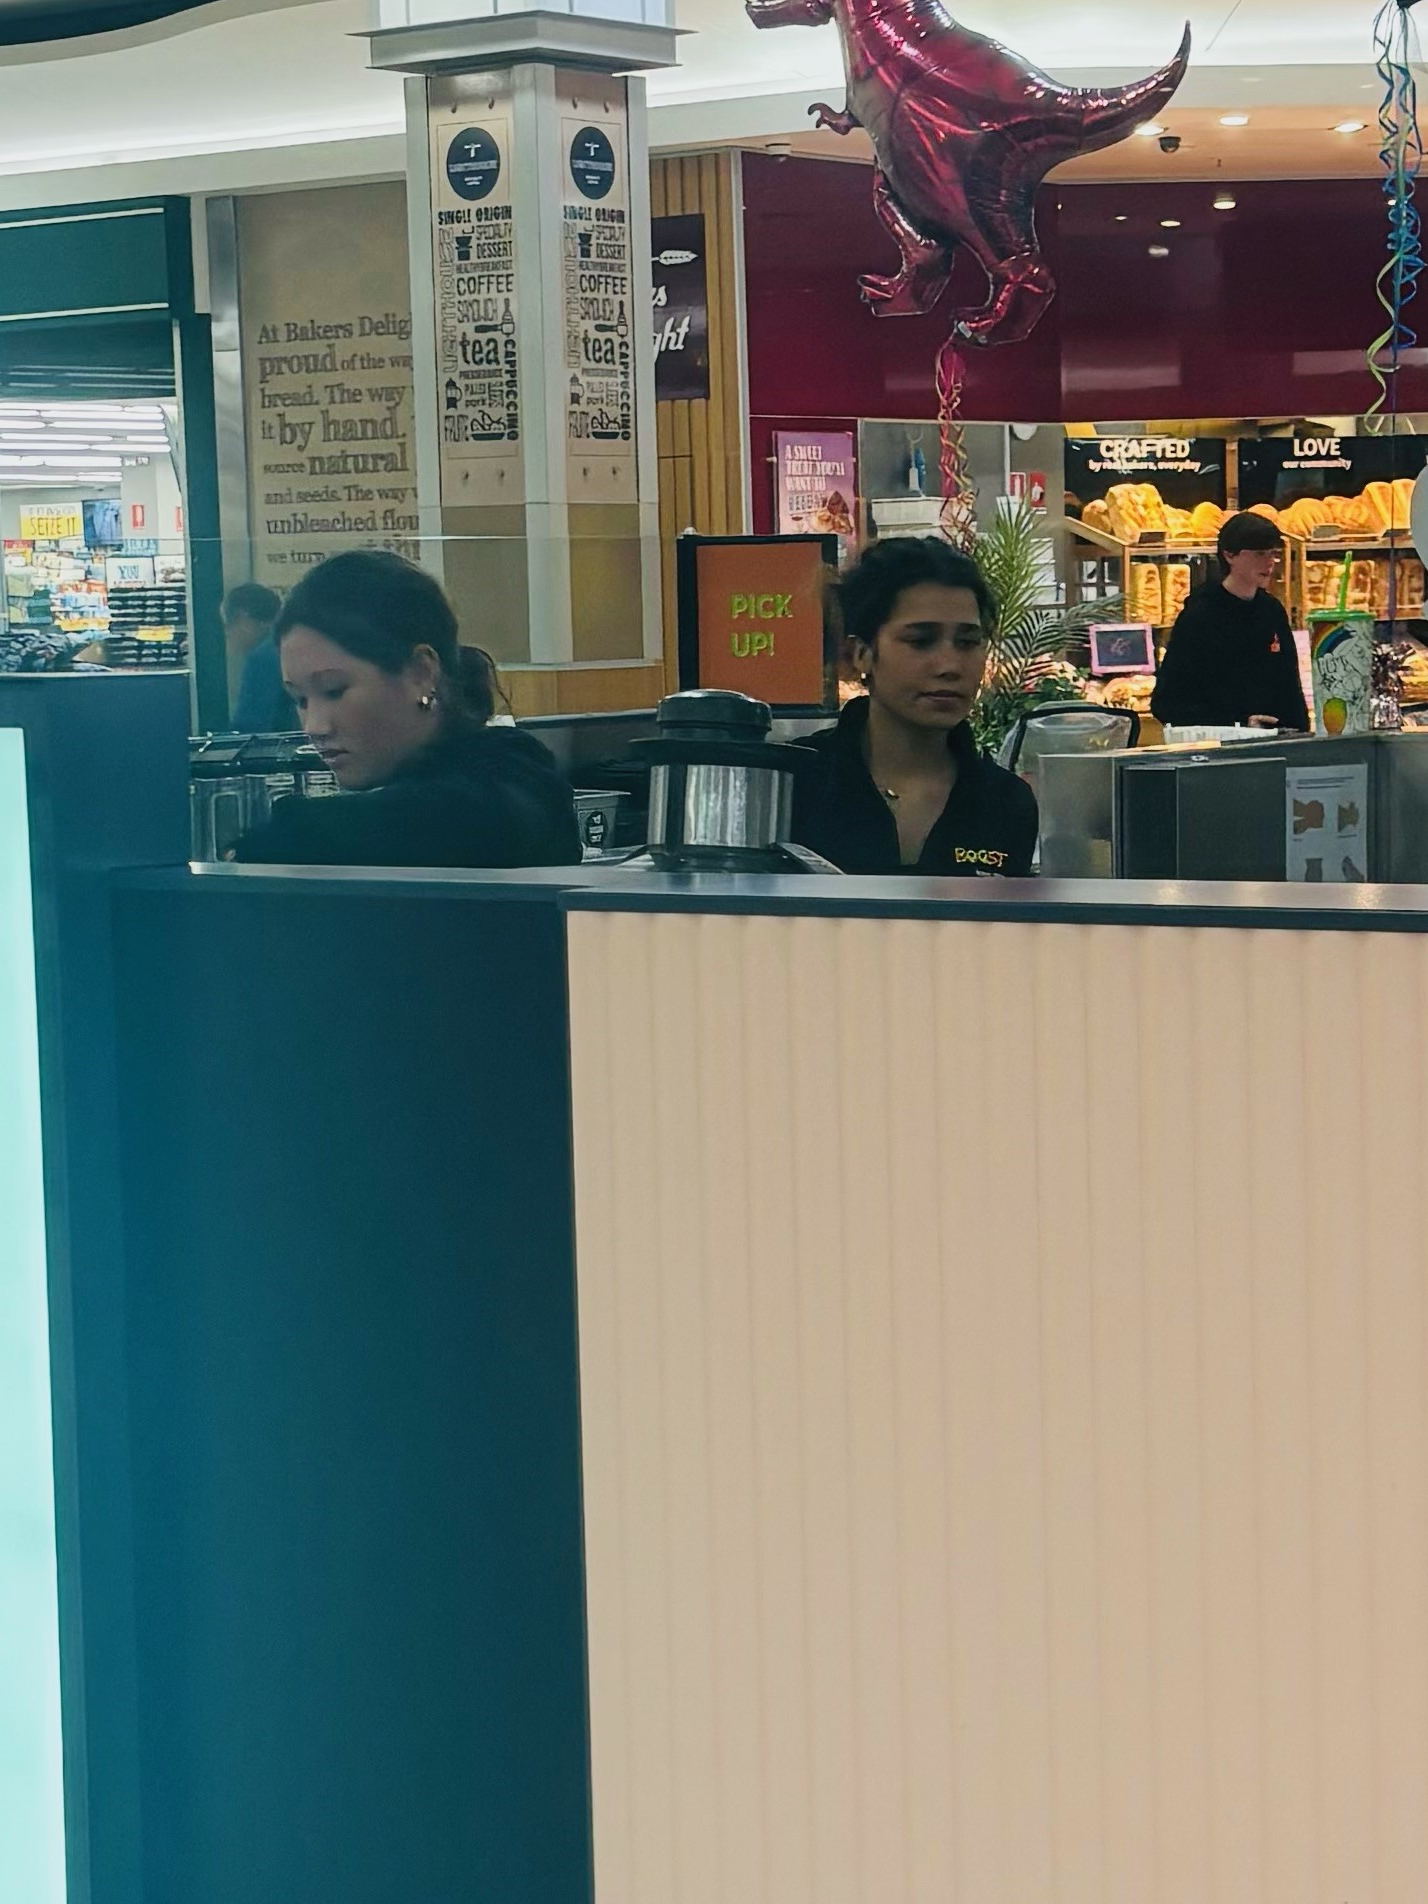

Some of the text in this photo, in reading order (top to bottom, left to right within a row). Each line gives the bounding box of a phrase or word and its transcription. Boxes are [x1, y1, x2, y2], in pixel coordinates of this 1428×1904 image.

[475, 205, 513, 223] ORIGIN
[476, 240, 513, 260] DESSERT
[456, 273, 515, 297] COFFEE
[579, 274, 628, 296] COFFEE
[258, 311, 412, 345] At Bakers Delig
[459, 332, 501, 367] tea
[582, 329, 617, 366] tea
[258, 344, 338, 384] proud
[341, 353, 357, 372] of
[360, 352, 386, 370] the
[260, 383, 406, 409] bread. The way
[504, 338, 520, 442] CAPPUCCINO
[618, 340, 632, 442] CAPPUCCINO
[262, 406, 407, 452] it by hand.
[263, 442, 409, 476] source natural
[784, 445, 793, 461] A
[1100, 438, 1191, 459] CRAFTED
[1293, 437, 1341, 457] LOVE
[1088, 459, 1102, 473] by
[265, 487, 295, 505] and
[343, 485, 375, 502] The
[377, 487, 412, 504] way
[30, 516, 64, 536] SEIZE
[265, 508, 420, 535] unbleached flou
[267, 553, 288, 565] we
[730, 593, 794, 619] PICK
[730, 631, 775, 658] UP!
[954, 847, 1009, 868] BOOST
